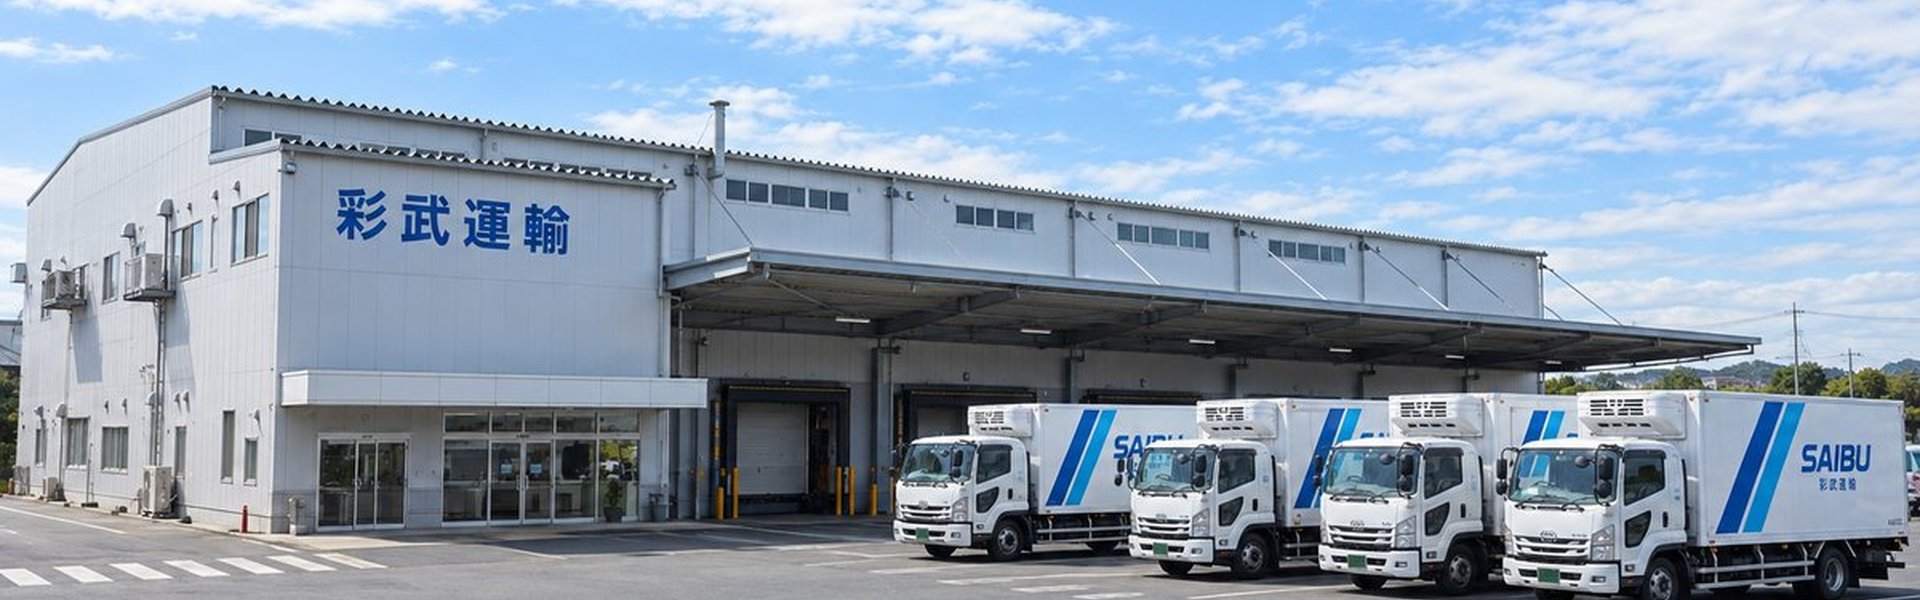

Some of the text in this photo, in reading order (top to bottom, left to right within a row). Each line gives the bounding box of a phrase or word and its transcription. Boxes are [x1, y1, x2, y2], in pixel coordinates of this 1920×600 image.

[337, 188, 570, 255] 彩武運輸
[1801, 444, 1871, 473] SAIBU
